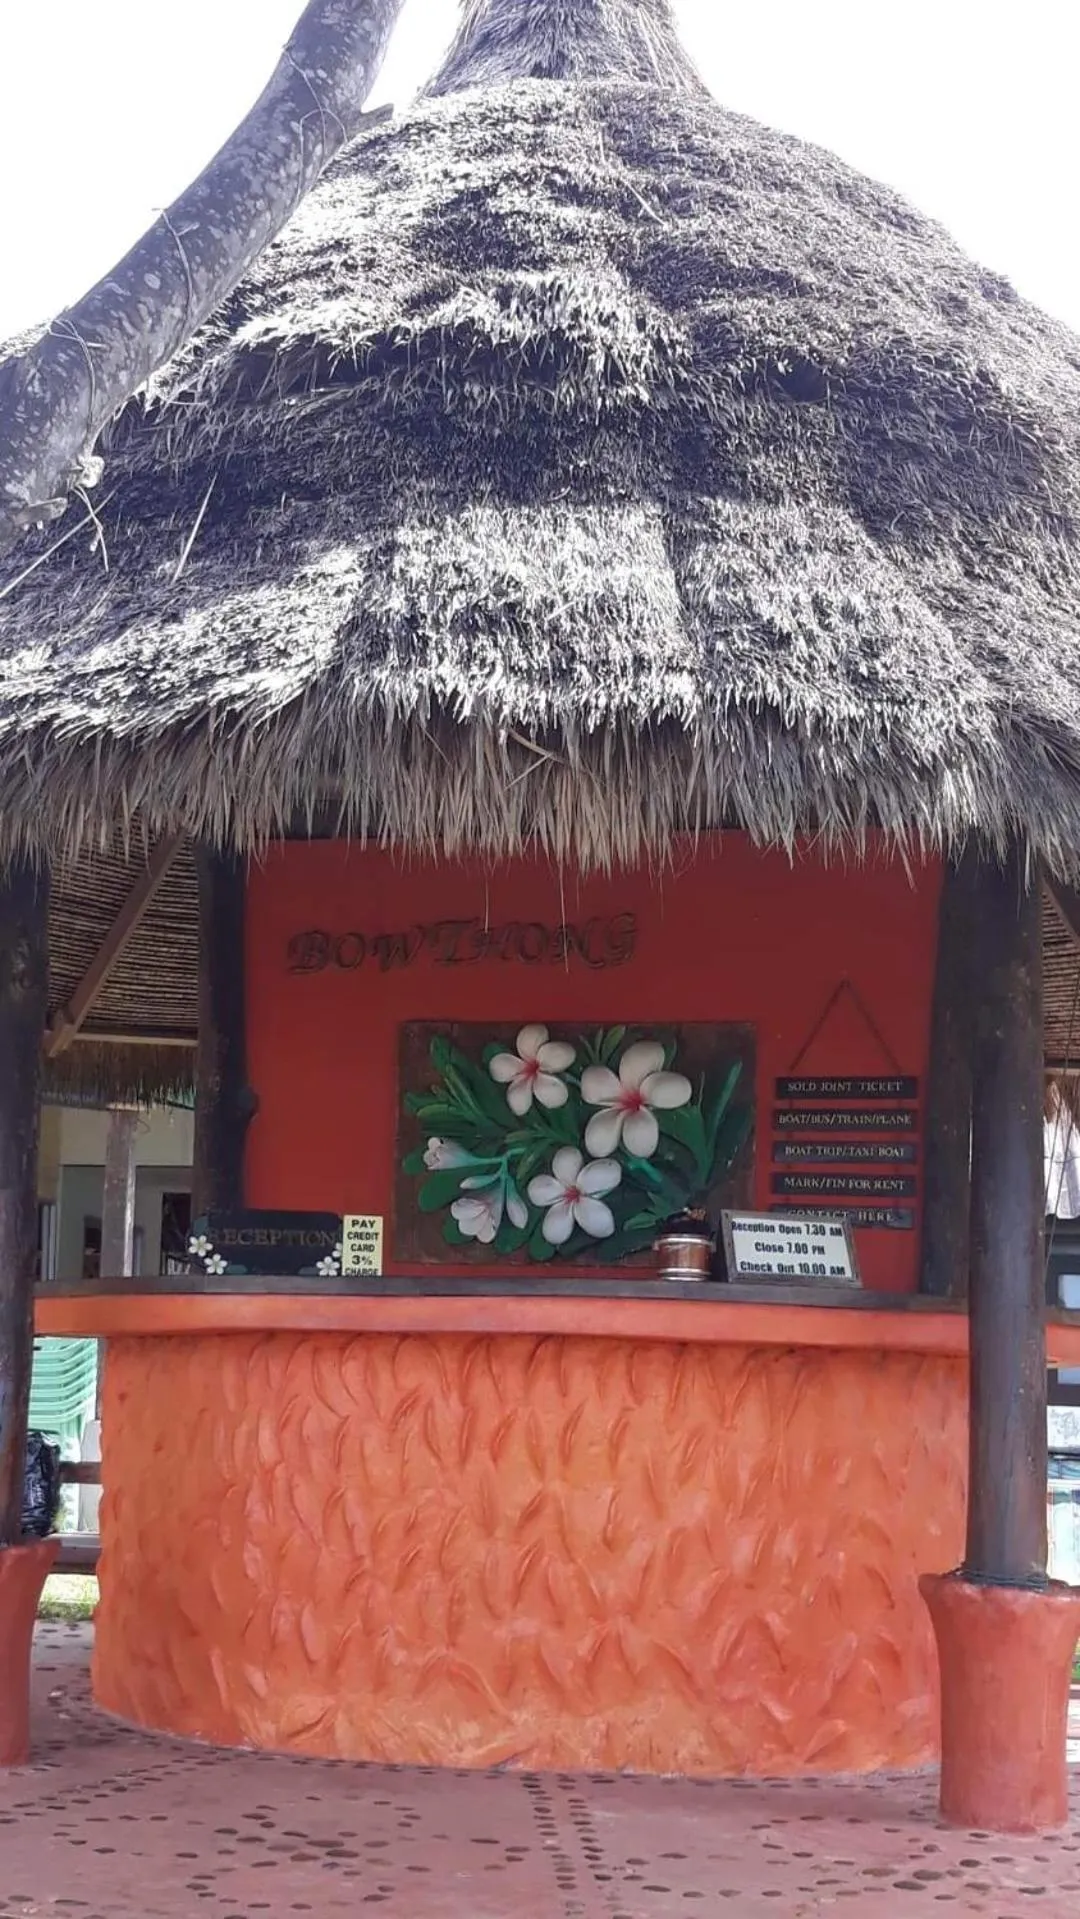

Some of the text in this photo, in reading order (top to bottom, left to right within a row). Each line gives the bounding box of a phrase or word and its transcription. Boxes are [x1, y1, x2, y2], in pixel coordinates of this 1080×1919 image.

[788, 1082, 903, 1092] SOLD JOINT TICKET
[785, 1146, 813, 1156] BOAT
[878, 1147, 905, 1157] BOAT
[784, 1177, 905, 1191] MARK/FIN FOR RENT
[858, 1211, 893, 1222] HERE
[351, 1219, 376, 1228] PAY
[731, 1221, 843, 1237] Reception Open 7.30 AM
[208, 1227, 337, 1246] RECEPTION
[347, 1231, 380, 1241] CREDIT
[350, 1243, 376, 1252] CARD
[754, 1241, 826, 1255] Close 7.00 PM
[351, 1255, 373, 1265] 3%
[740, 1260, 846, 1276] Check Out 10.00 AM
